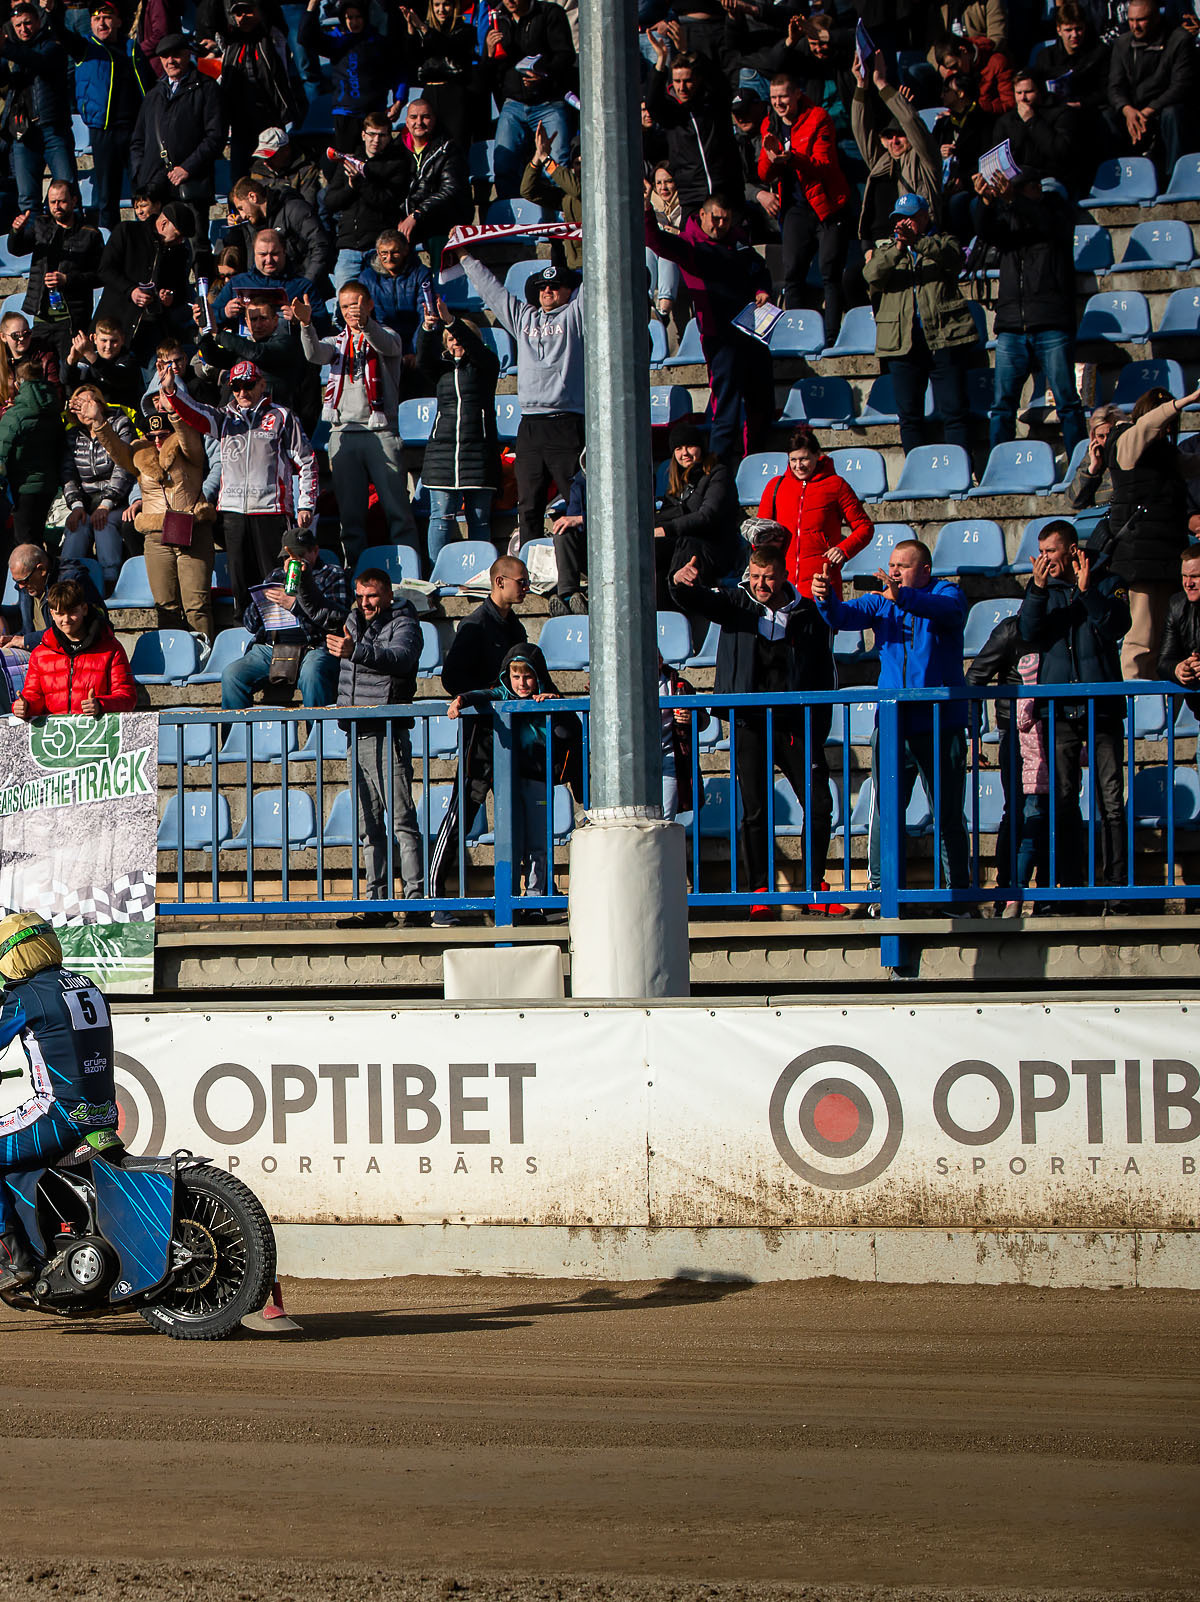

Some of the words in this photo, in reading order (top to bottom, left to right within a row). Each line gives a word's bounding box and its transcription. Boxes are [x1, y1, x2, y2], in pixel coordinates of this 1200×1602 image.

[1114, 165, 1133, 177] 25
[1112, 299, 1128, 312] 26
[787, 317, 804, 331] 22
[417, 404, 430, 423] 18
[497, 404, 514, 420] 19
[931, 455, 950, 469] 25
[1015, 450, 1033, 464] 26
[876, 534, 894, 546] 25
[962, 530, 980, 543] 26
[461, 553, 476, 568] 20
[566, 628, 583, 643] 22
[41, 717, 109, 758] 52
[22, 780, 39, 809] ON
[43, 773, 70, 806] THE
[75, 751, 147, 801] TRACK
[191, 805, 207, 817] 19
[58, 975, 90, 989] LJUNG
[76, 991, 98, 1025] 5
[193, 1063, 536, 1145] OPTIBET
[933, 1059, 1200, 1146] OPTIB
[228, 1156, 380, 1175] PORTA
[419, 1152, 538, 1175] BĀRS
[937, 1157, 1140, 1175] SPORTA
